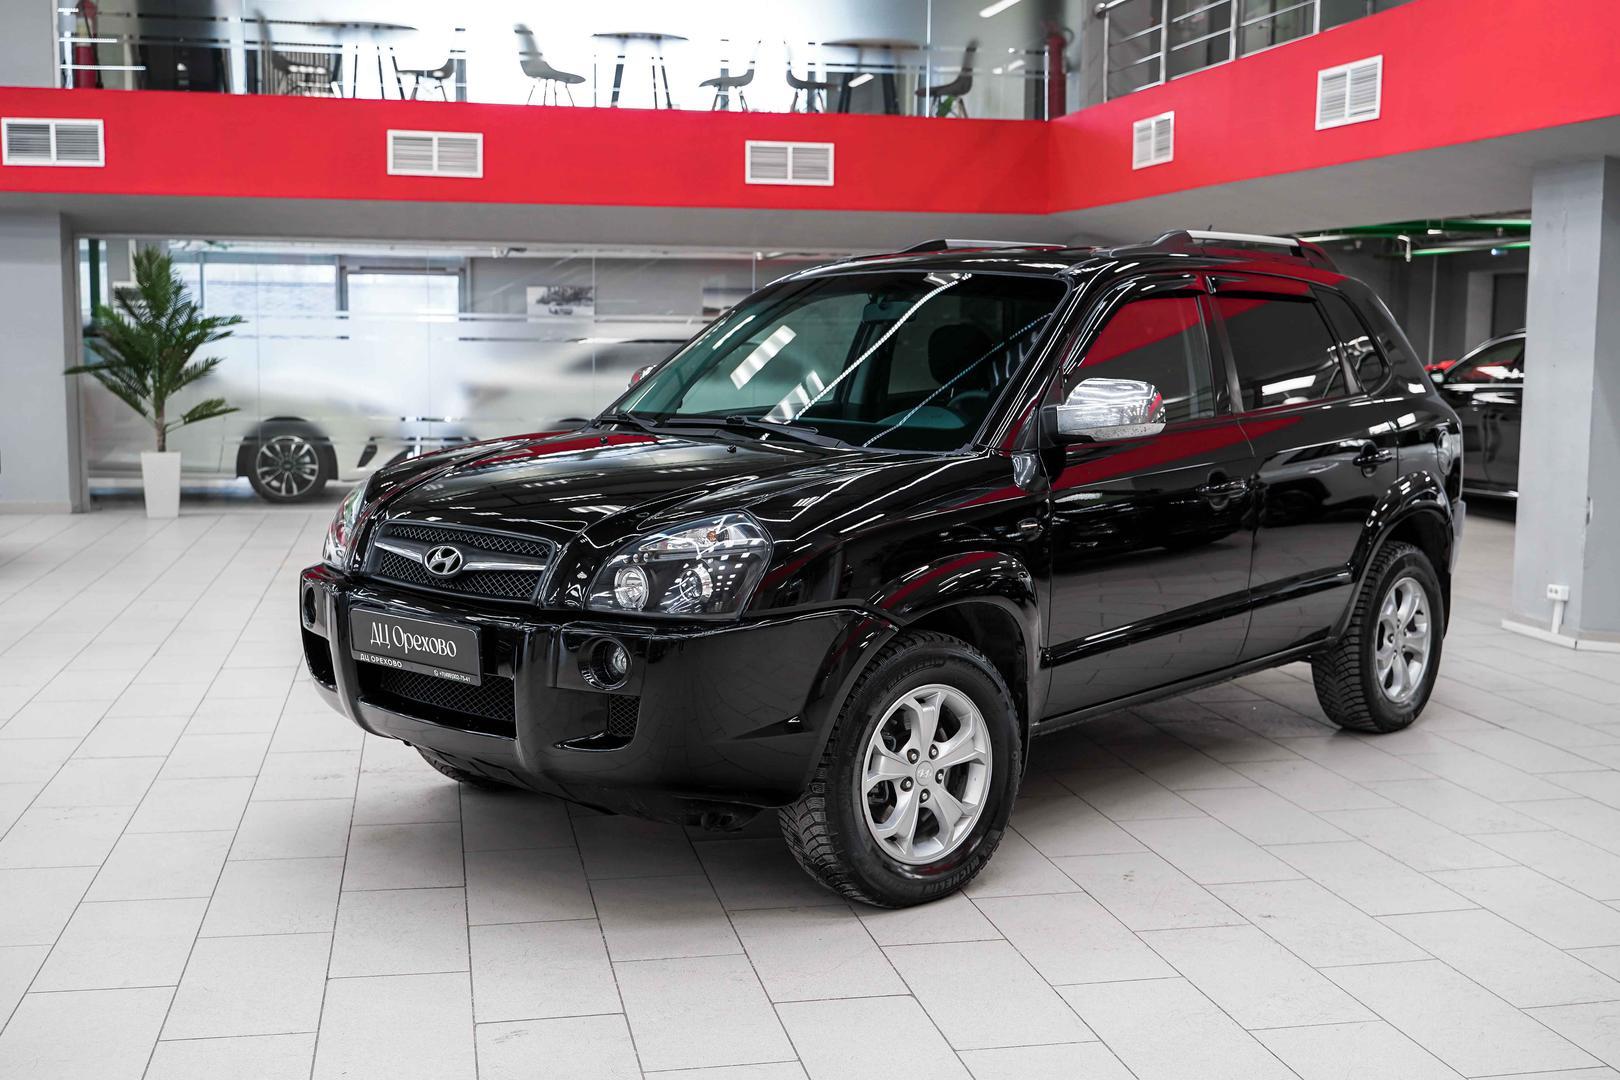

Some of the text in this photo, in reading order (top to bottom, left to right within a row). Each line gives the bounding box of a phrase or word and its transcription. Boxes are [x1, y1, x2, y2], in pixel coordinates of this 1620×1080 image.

[370, 621, 457, 658] ДЦ Орехово
[360, 653, 403, 668] ДЦ ОРЕХОВО
